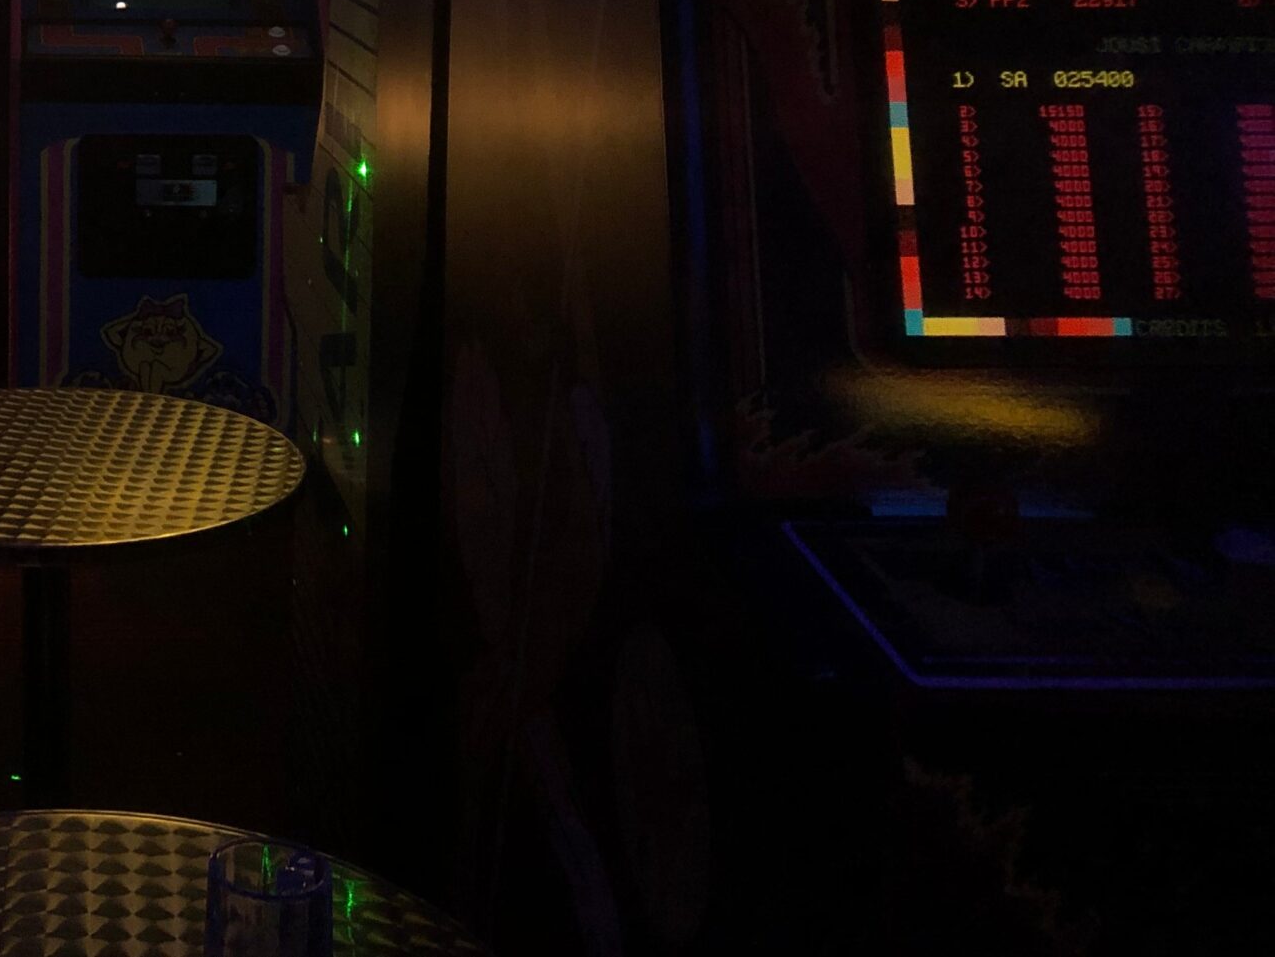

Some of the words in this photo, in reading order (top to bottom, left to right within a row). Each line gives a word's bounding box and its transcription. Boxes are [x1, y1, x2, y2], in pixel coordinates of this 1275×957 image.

[952, 71, 975, 88] 1)
[999, 70, 1029, 88] SA
[1053, 70, 1136, 88] 025400
